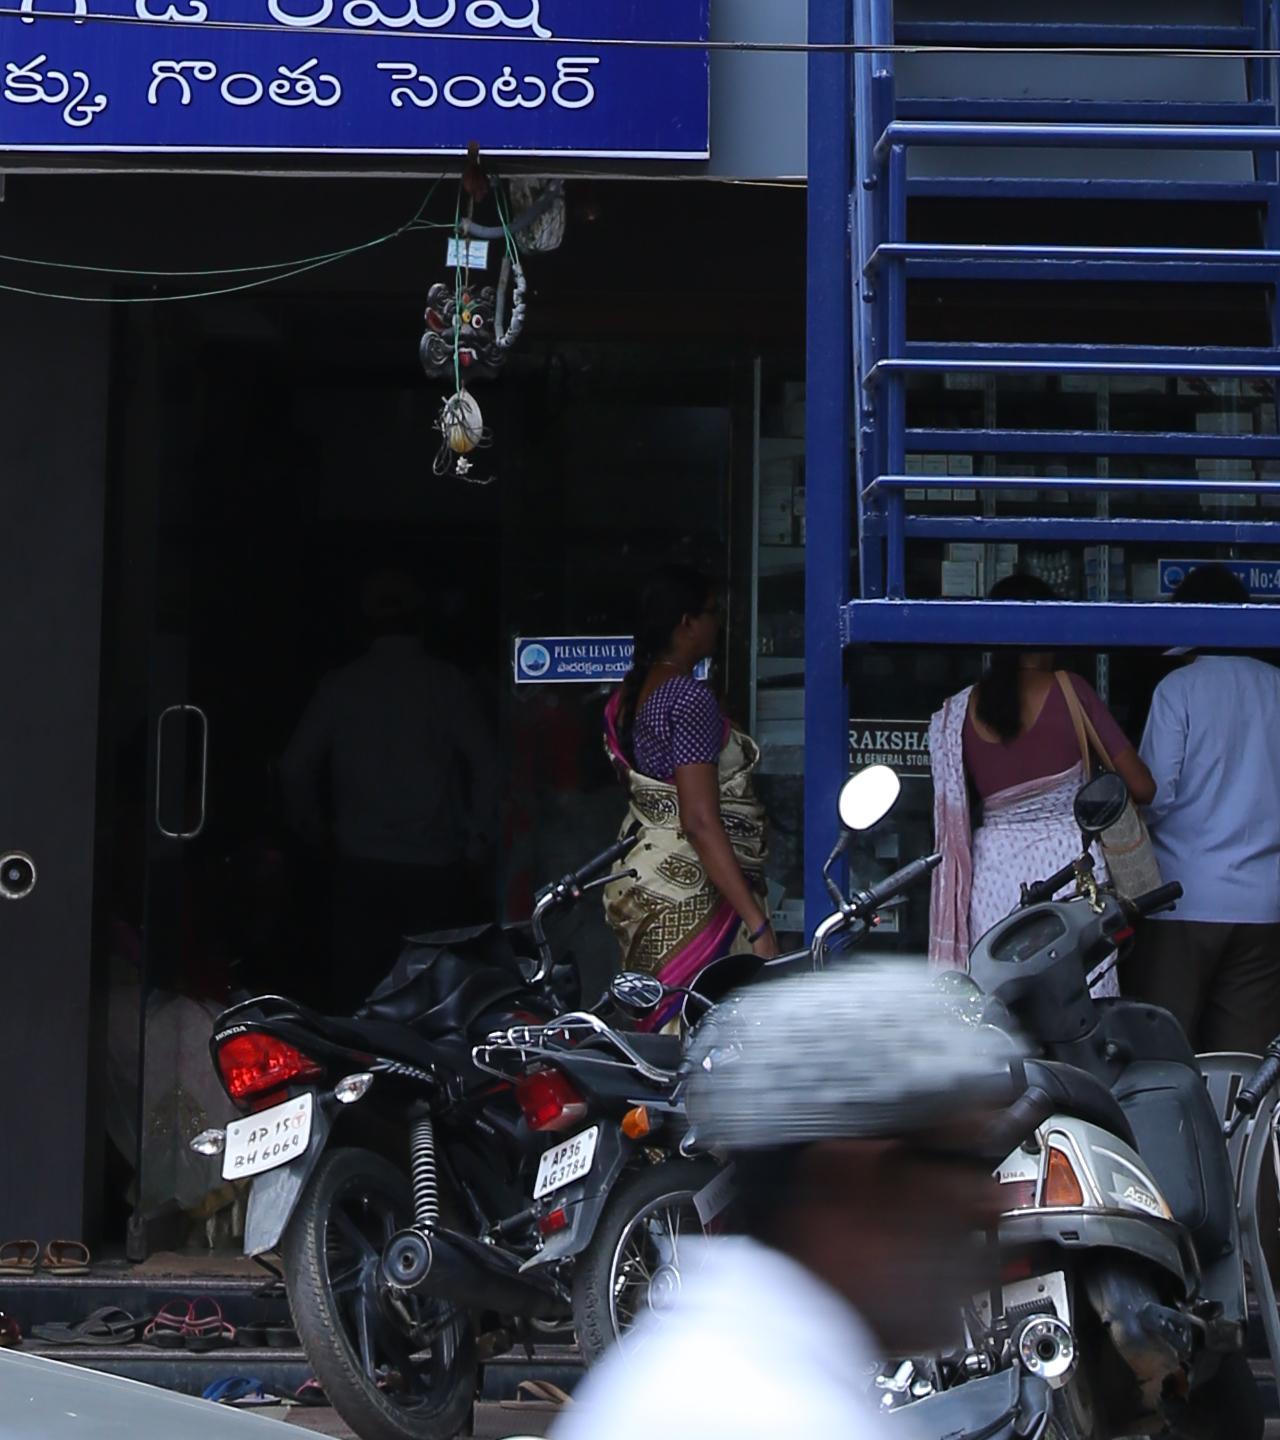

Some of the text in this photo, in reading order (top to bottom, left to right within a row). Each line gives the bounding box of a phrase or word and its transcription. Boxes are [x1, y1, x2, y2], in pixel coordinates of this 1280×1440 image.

[147, 58, 342, 106] గొంతు
[377, 56, 601, 109] సెంటర్
[554, 644, 587, 658] PLEASE
[589, 644, 617, 658] LEAVE
[864, 753, 904, 766] GENERAL
[906, 754, 931, 766] STOR
[215, 1025, 247, 1041] HONDA
[247, 1128, 268, 1146] AP
